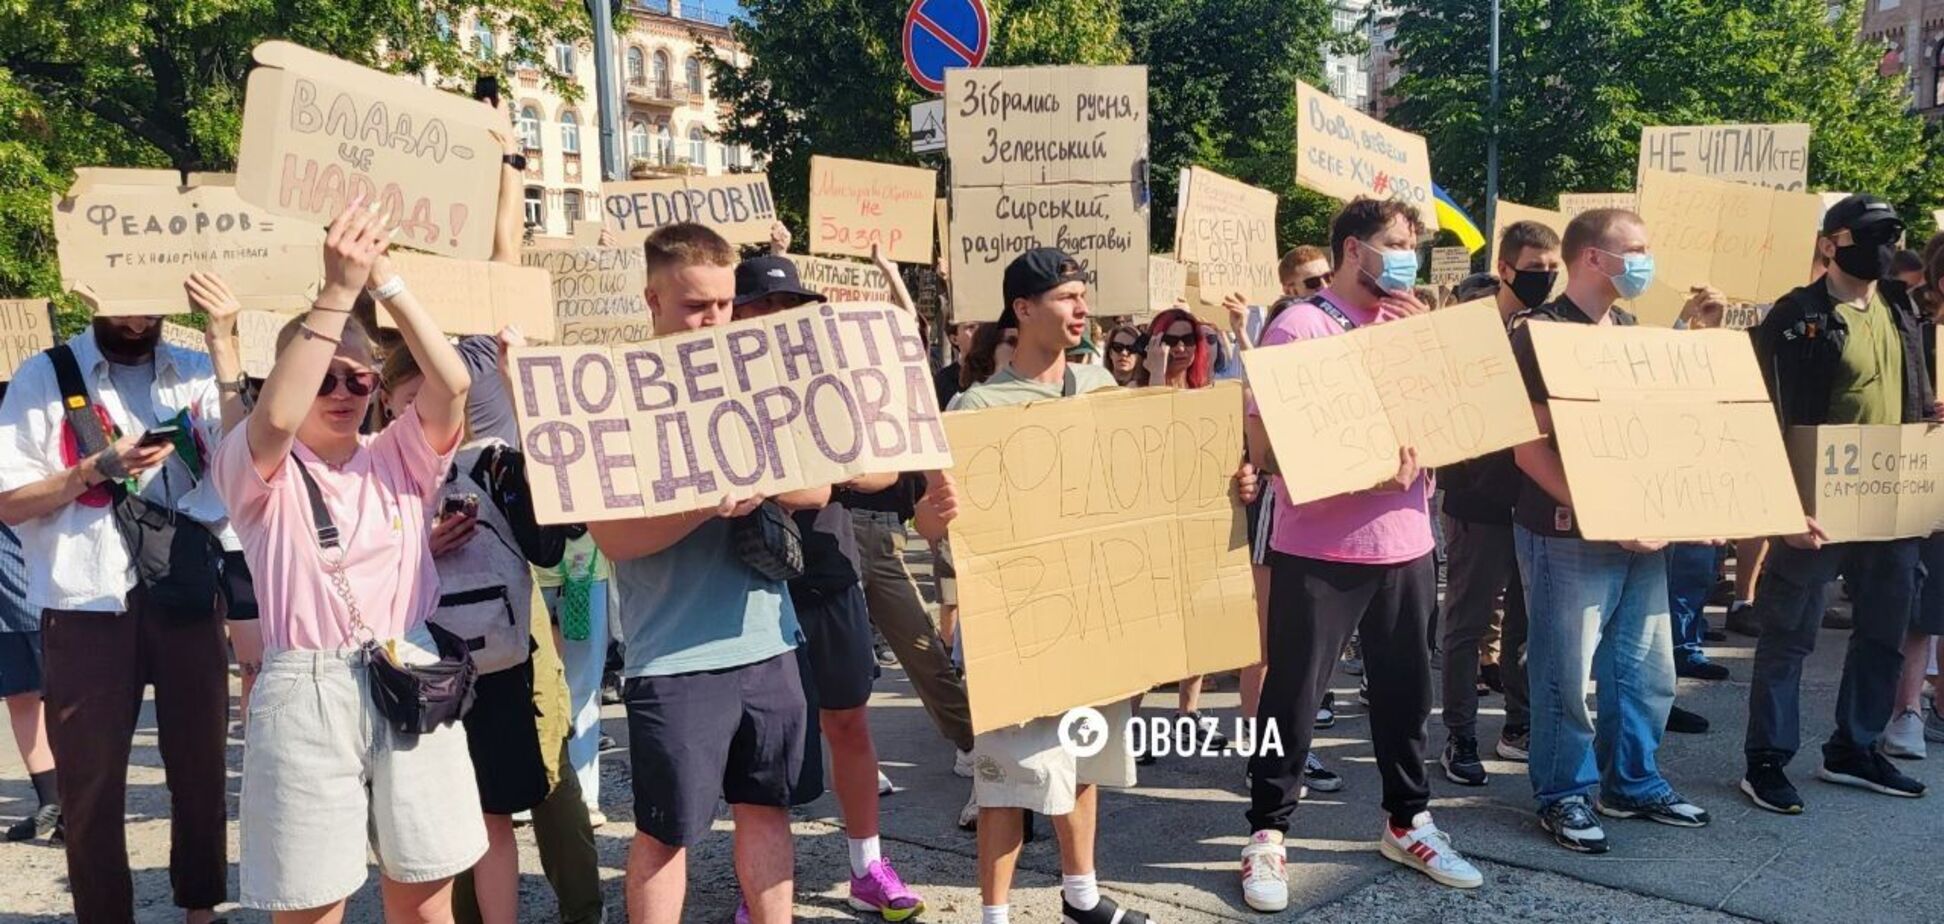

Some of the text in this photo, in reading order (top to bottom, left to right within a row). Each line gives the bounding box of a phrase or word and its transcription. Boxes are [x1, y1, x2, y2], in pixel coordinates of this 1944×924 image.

[960, 79, 1140, 122] Зібрались русня,
[338, 142, 375, 172] ЦЕ
[982, 127, 1107, 164] Зеленський
[1649, 132, 1693, 173] НЕ
[996, 194, 1110, 231] Сирський,
[1198, 219, 1266, 243] СКЕЛЮ
[962, 225, 1132, 264] радіють відставці
[517, 305, 925, 417] ПОВЕРНІТЬ
[1268, 326, 1448, 404] LACTOSE
[1297, 355, 1509, 438] INTOLERANCE
[526, 366, 947, 512] ФЕДОРОВА
[1679, 412, 1757, 460] ЗА
[1824, 443, 1929, 476] 12 СОТНЯ
[1823, 480, 1935, 498] САМООБОРОНИ
